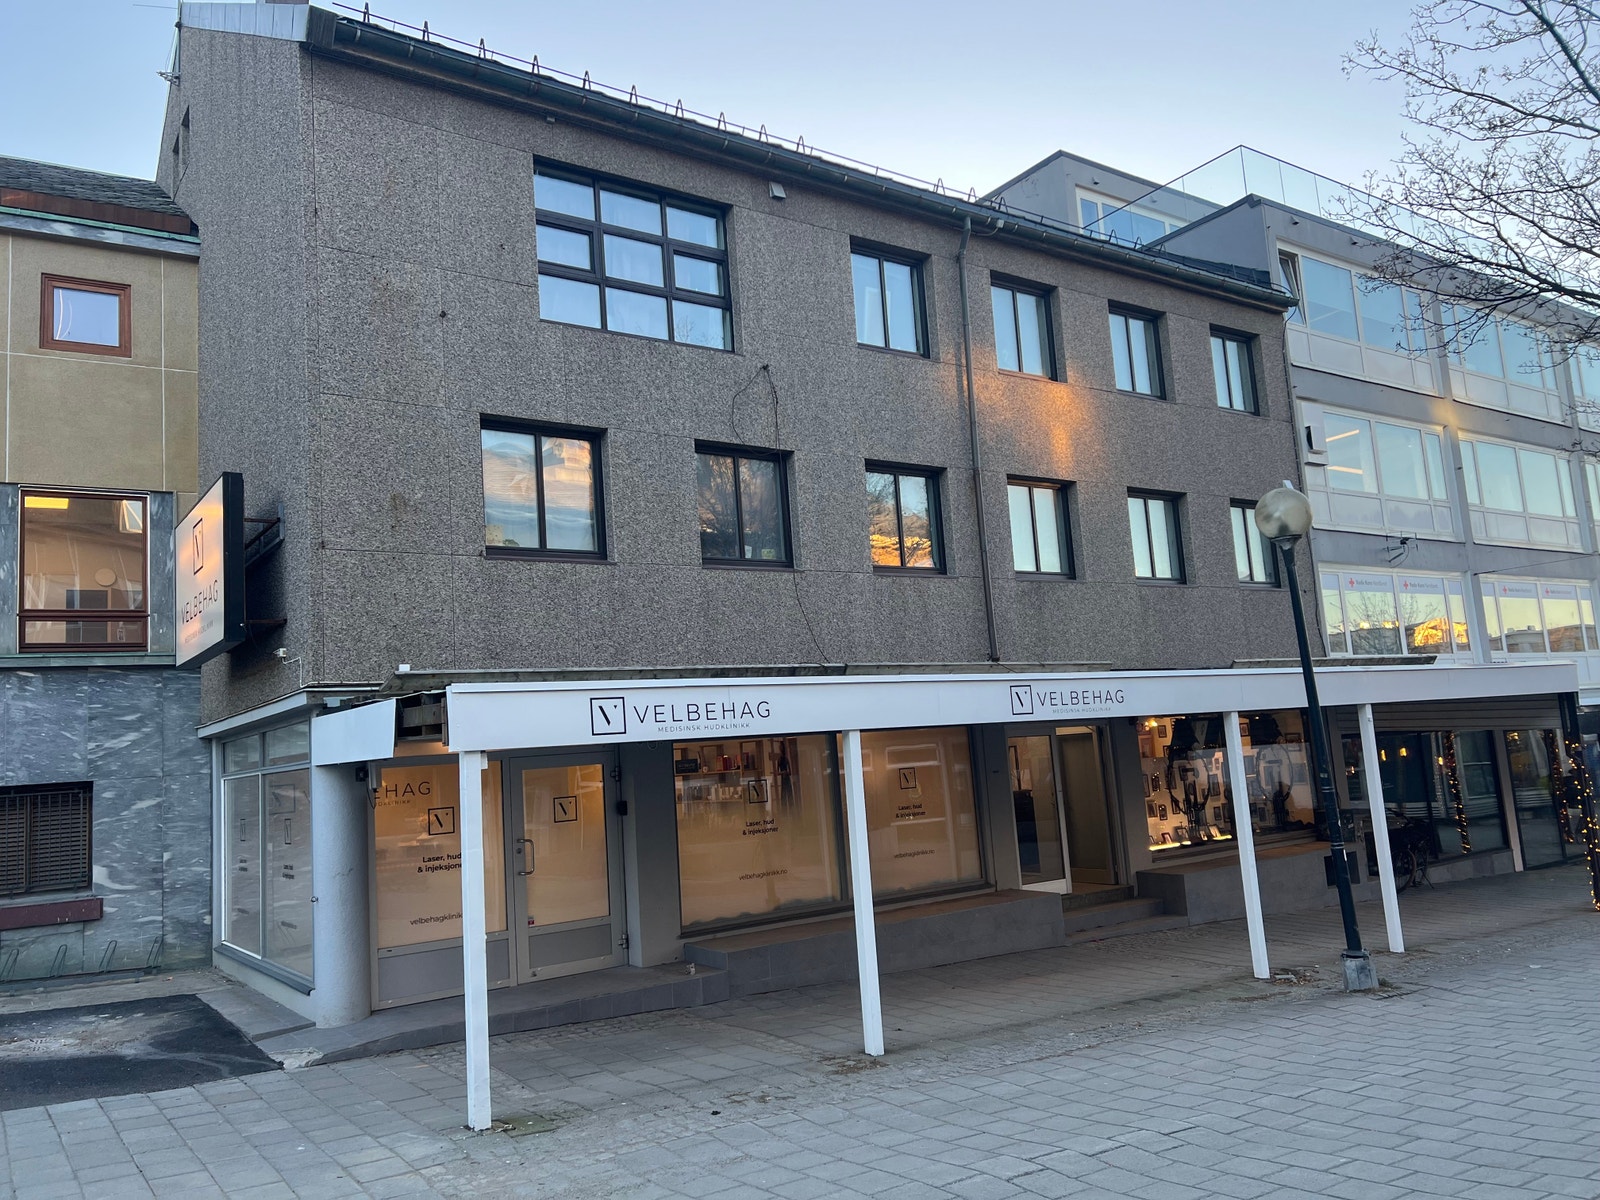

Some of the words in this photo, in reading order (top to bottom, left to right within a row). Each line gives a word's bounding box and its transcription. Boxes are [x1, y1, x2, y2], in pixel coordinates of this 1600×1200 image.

[181, 579, 219, 625] VELBEHAG
[1036, 689, 1125, 707] VELBEHAG
[633, 700, 771, 724] VELBEHAG
[657, 724, 702, 733] MEDISINSK
[704, 722, 751, 731] HUDKLINIKK
[763, 818, 775, 826] hud
[748, 827, 779, 836] injeksjoner
[422, 855, 445, 864] Laser,
[446, 852, 462, 861] hud
[417, 866, 423, 874] &
